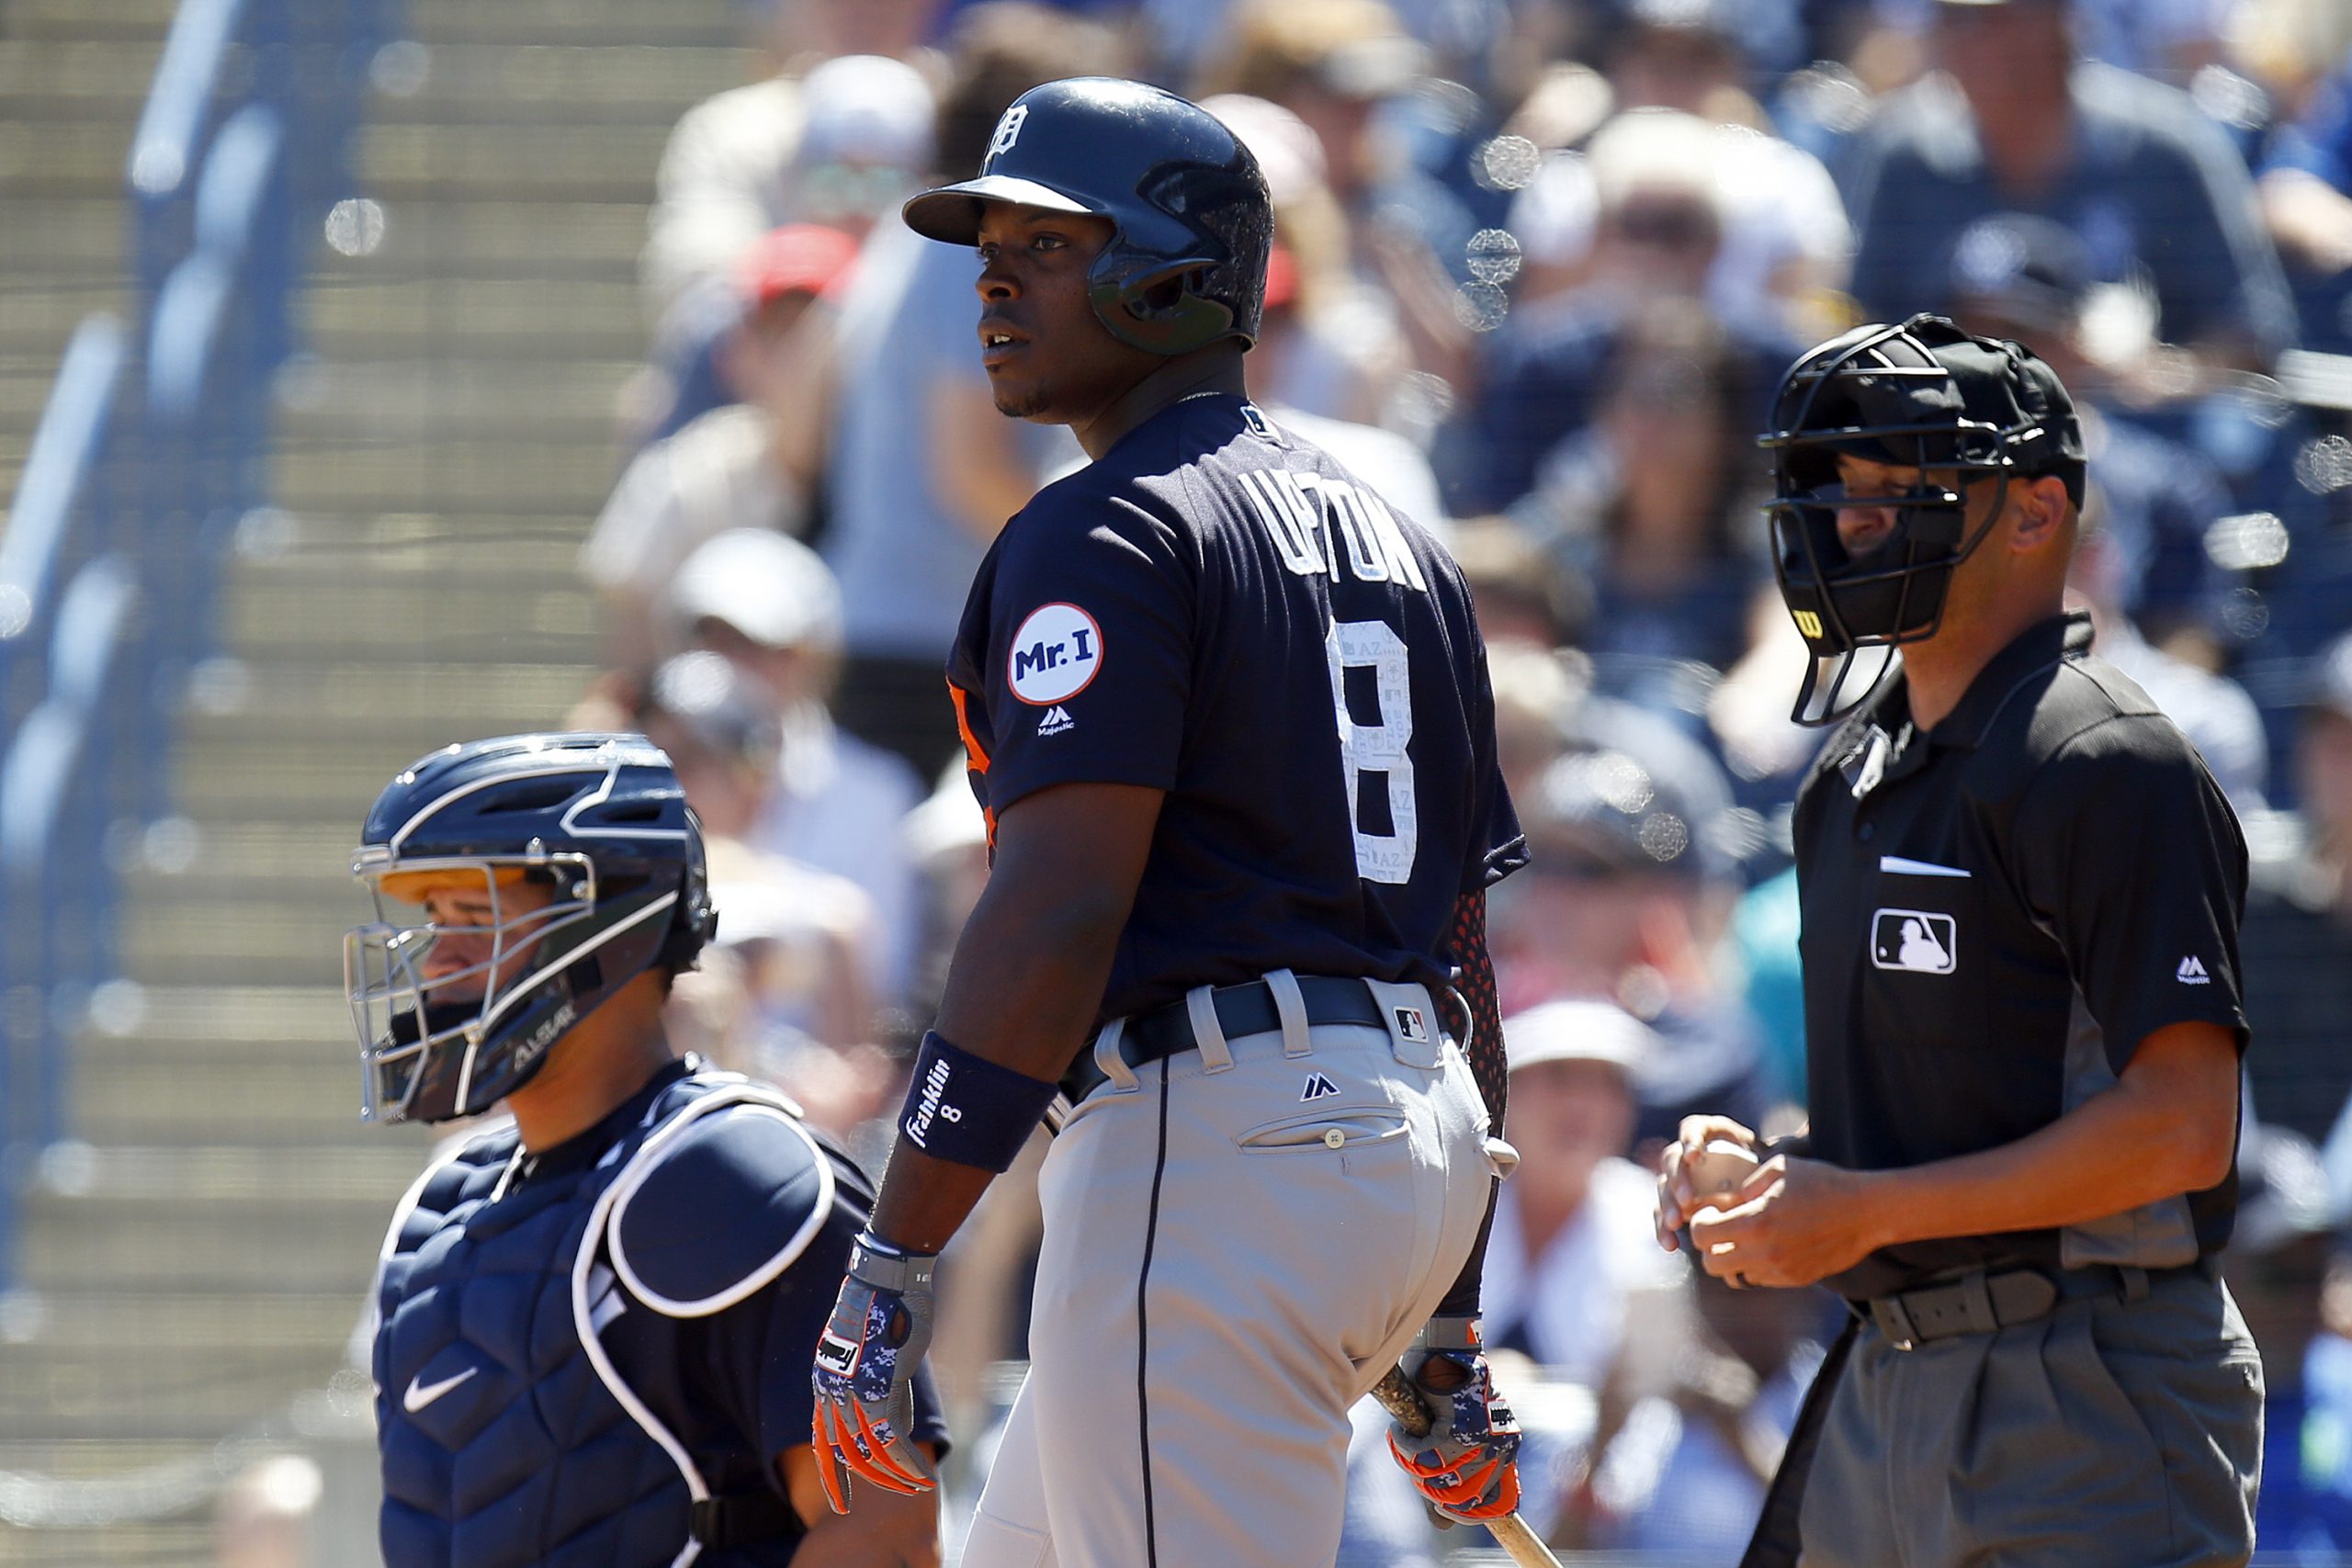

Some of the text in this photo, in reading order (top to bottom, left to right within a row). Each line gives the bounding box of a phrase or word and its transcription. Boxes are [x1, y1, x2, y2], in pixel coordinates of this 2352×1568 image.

[1238, 468, 1428, 592] UPTON
[1015, 628, 1093, 682] Mr. I
[1037, 721, 1075, 737] Majestic
[1325, 615, 1418, 885] 8
[940, 1104, 963, 1123] 8
